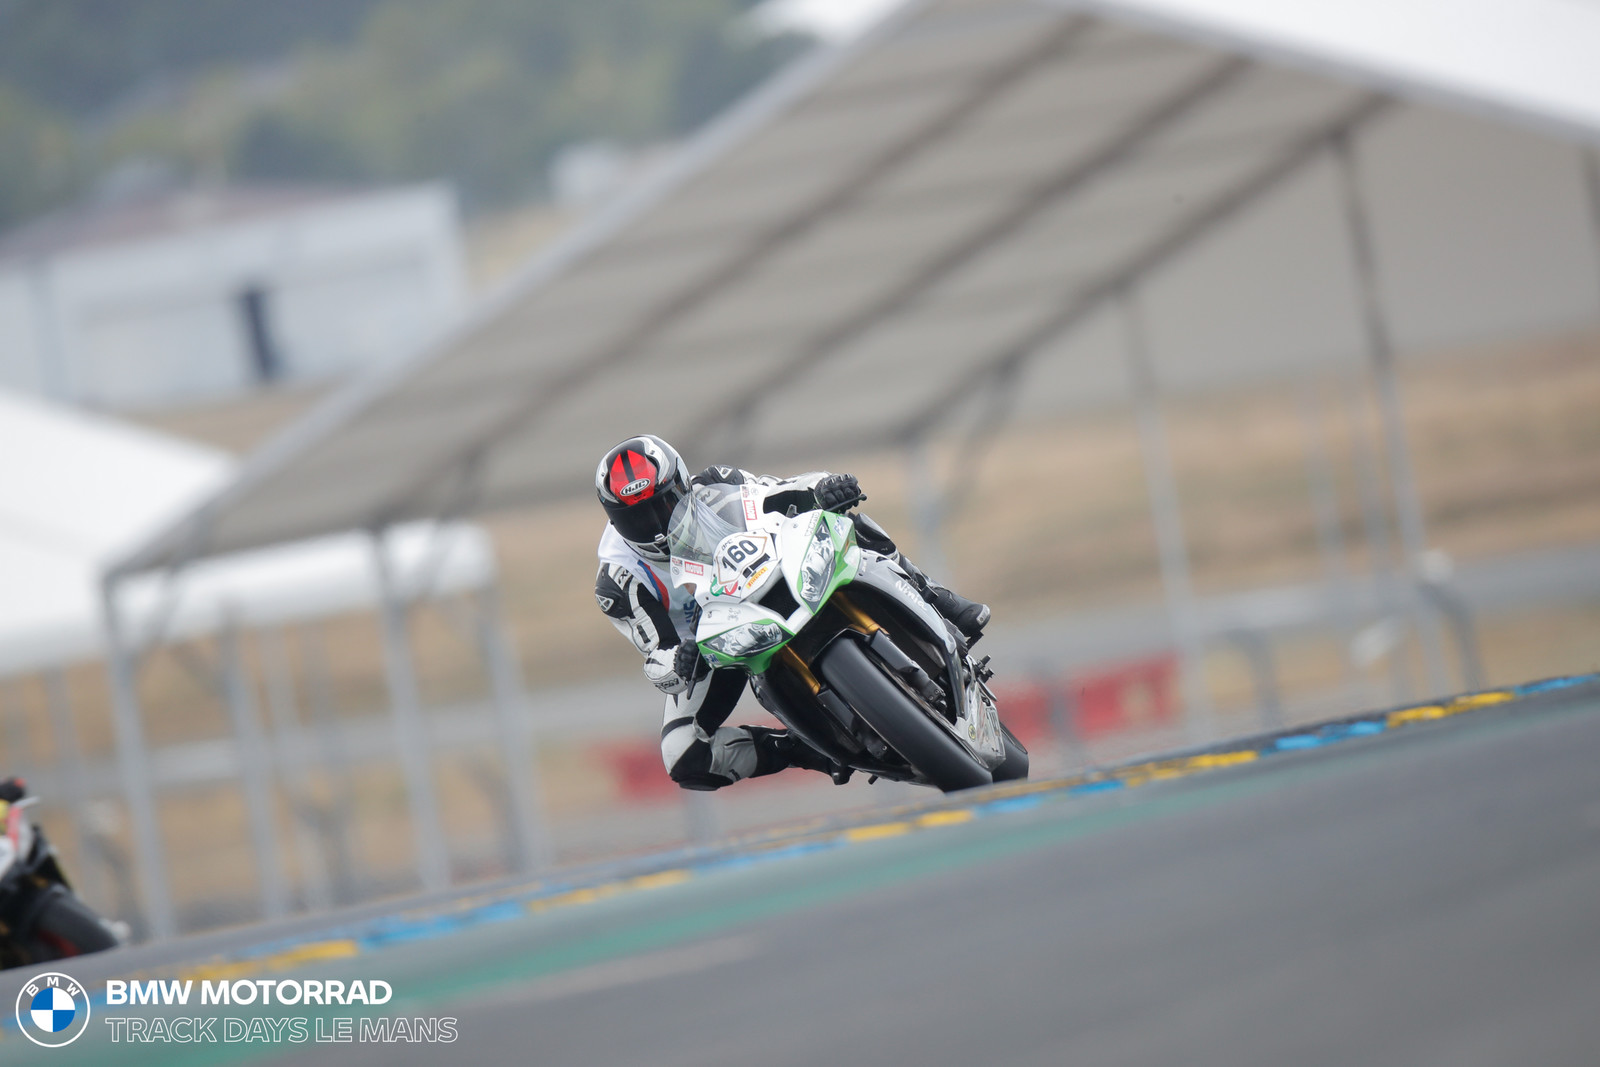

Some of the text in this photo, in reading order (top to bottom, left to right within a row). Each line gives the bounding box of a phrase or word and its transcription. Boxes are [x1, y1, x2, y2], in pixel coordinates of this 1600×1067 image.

[624, 479, 648, 494] HJC
[721, 539, 758, 572] 160
[895, 579, 928, 611] Ninja
